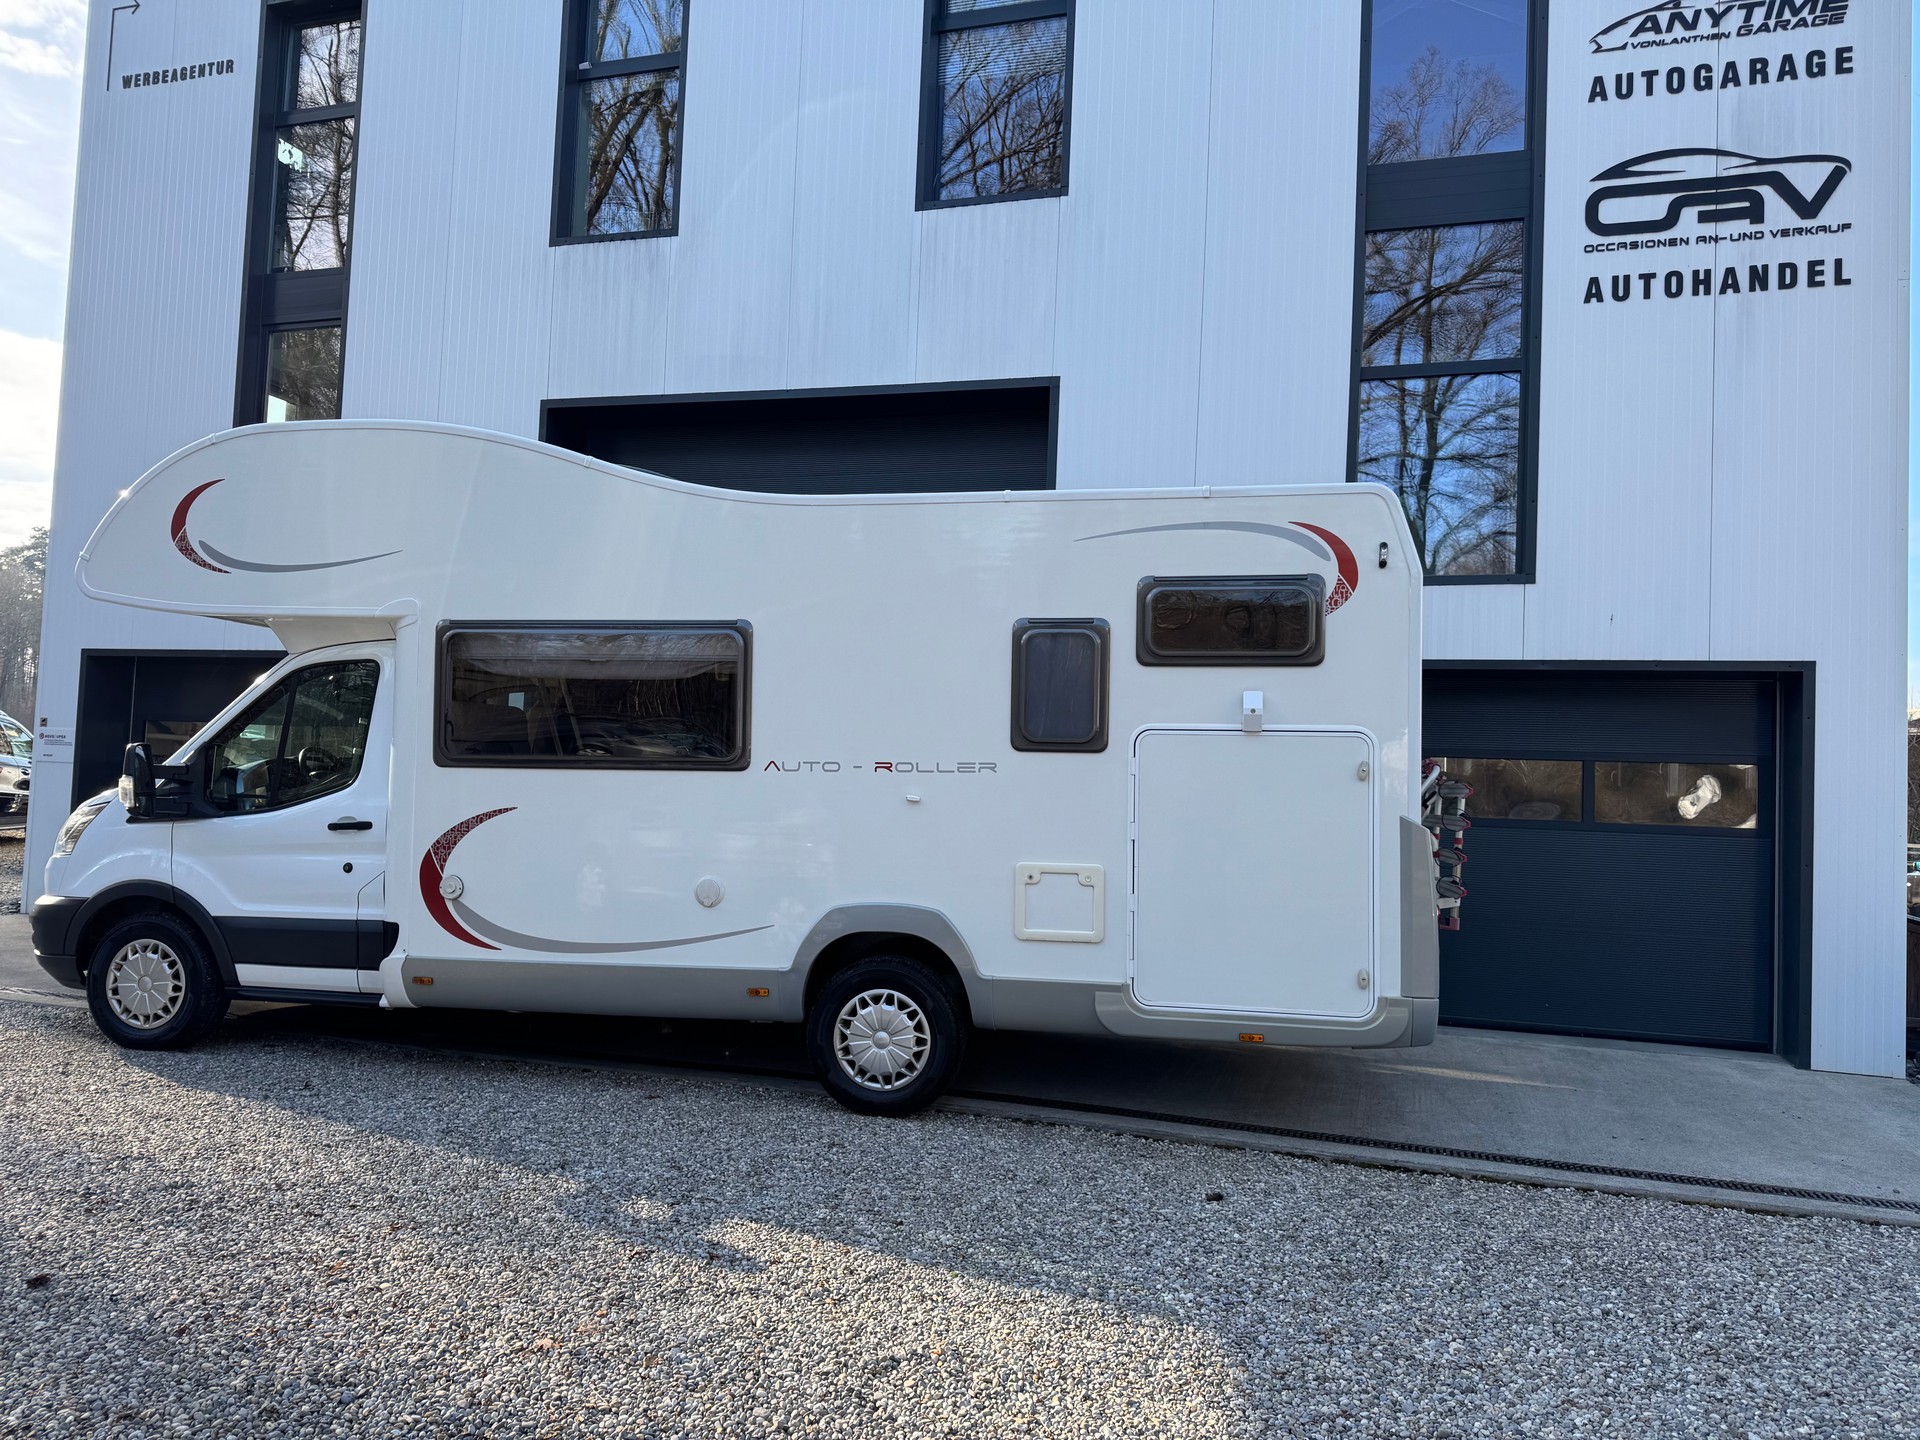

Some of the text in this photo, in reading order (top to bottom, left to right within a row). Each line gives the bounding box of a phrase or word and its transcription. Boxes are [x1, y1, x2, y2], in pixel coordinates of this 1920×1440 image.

[1629, 0, 1849, 37] ANYTIME
[1631, 12, 1847, 50] VONLANTHEN GARAGE
[121, 59, 234, 89] WERBEAGENTUR
[1587, 45, 1854, 103] AUTOGARAGE
[1583, 236, 1690, 254] OCCASIONEN
[1769, 222, 1852, 239] VERKAUF
[1583, 257, 1852, 304] AUTOHANDEL
[763, 760, 842, 773] AUTO
[874, 761, 998, 774] ROLLER
